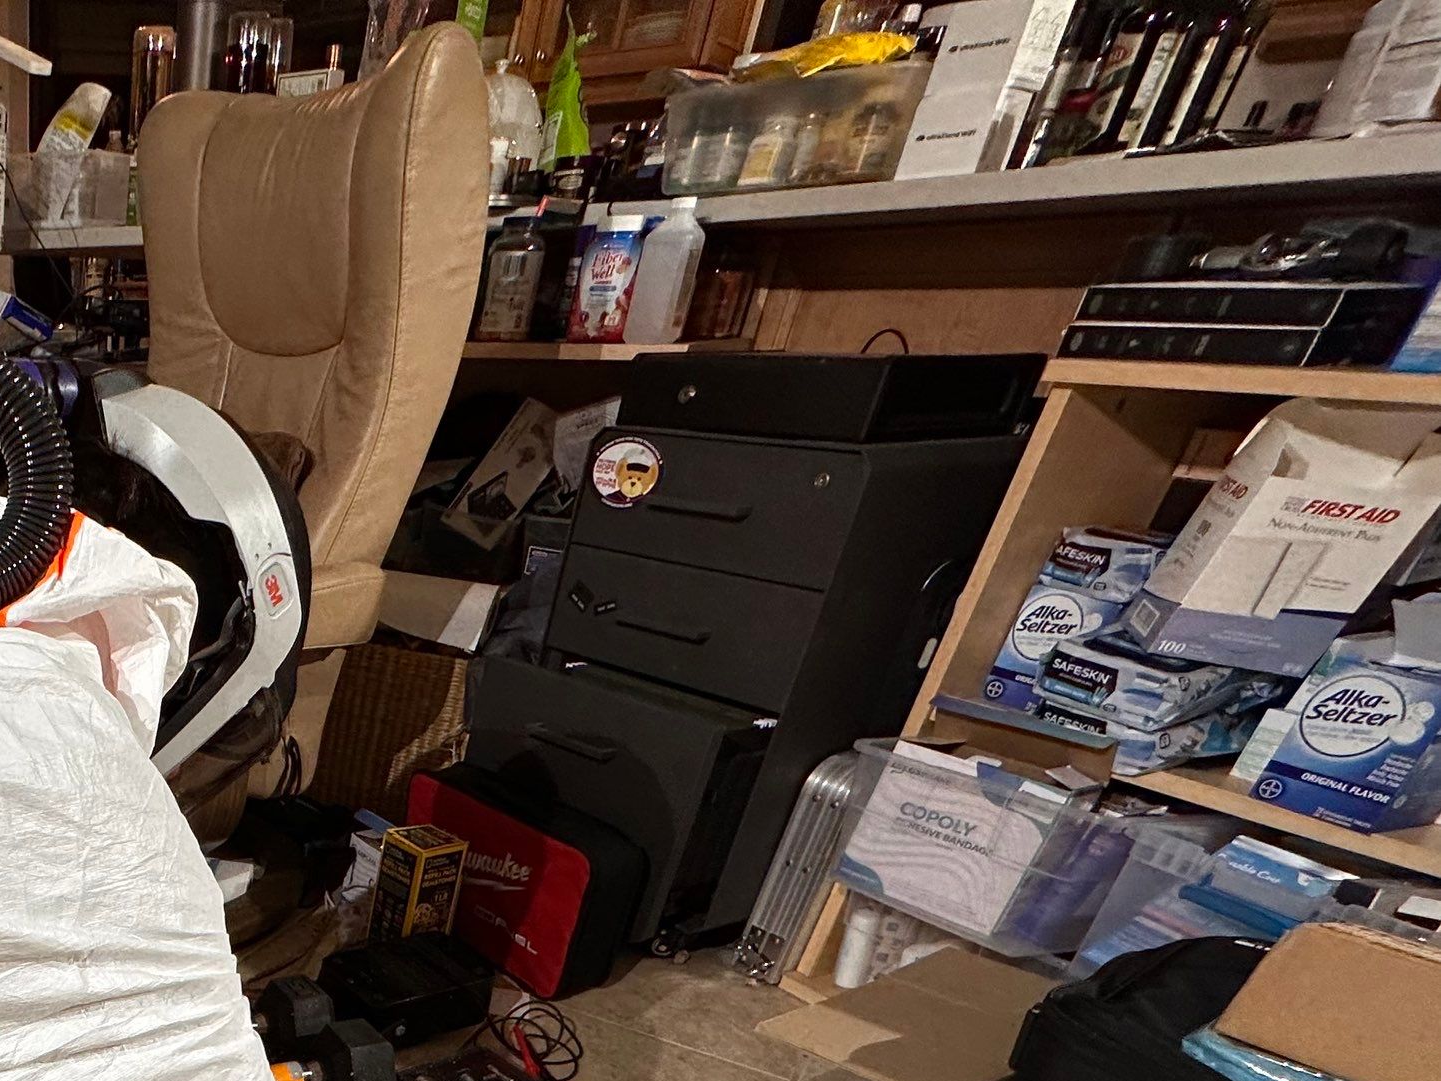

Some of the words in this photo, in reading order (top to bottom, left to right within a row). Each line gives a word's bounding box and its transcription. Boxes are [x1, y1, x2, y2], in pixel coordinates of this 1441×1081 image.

[591, 264, 615, 280] Well
[1301, 499, 1364, 519] FIRST
[1354, 506, 1401, 524] AID
[1055, 544, 1106, 566] AFESKIN
[265, 574, 284, 608] 3M
[1027, 605, 1073, 619] Alka-
[1016, 618, 1078, 635] Seltzer
[1158, 639, 1187, 655] 100
[1052, 658, 1111, 684] SAFESKIN
[1320, 688, 1391, 708] Alka-
[1305, 704, 1398, 727] Seltzer
[1301, 772, 1349, 792] ORIGINAL
[1349, 786, 1391, 804] FLAVOR
[899, 801, 978, 836] COPOLY
